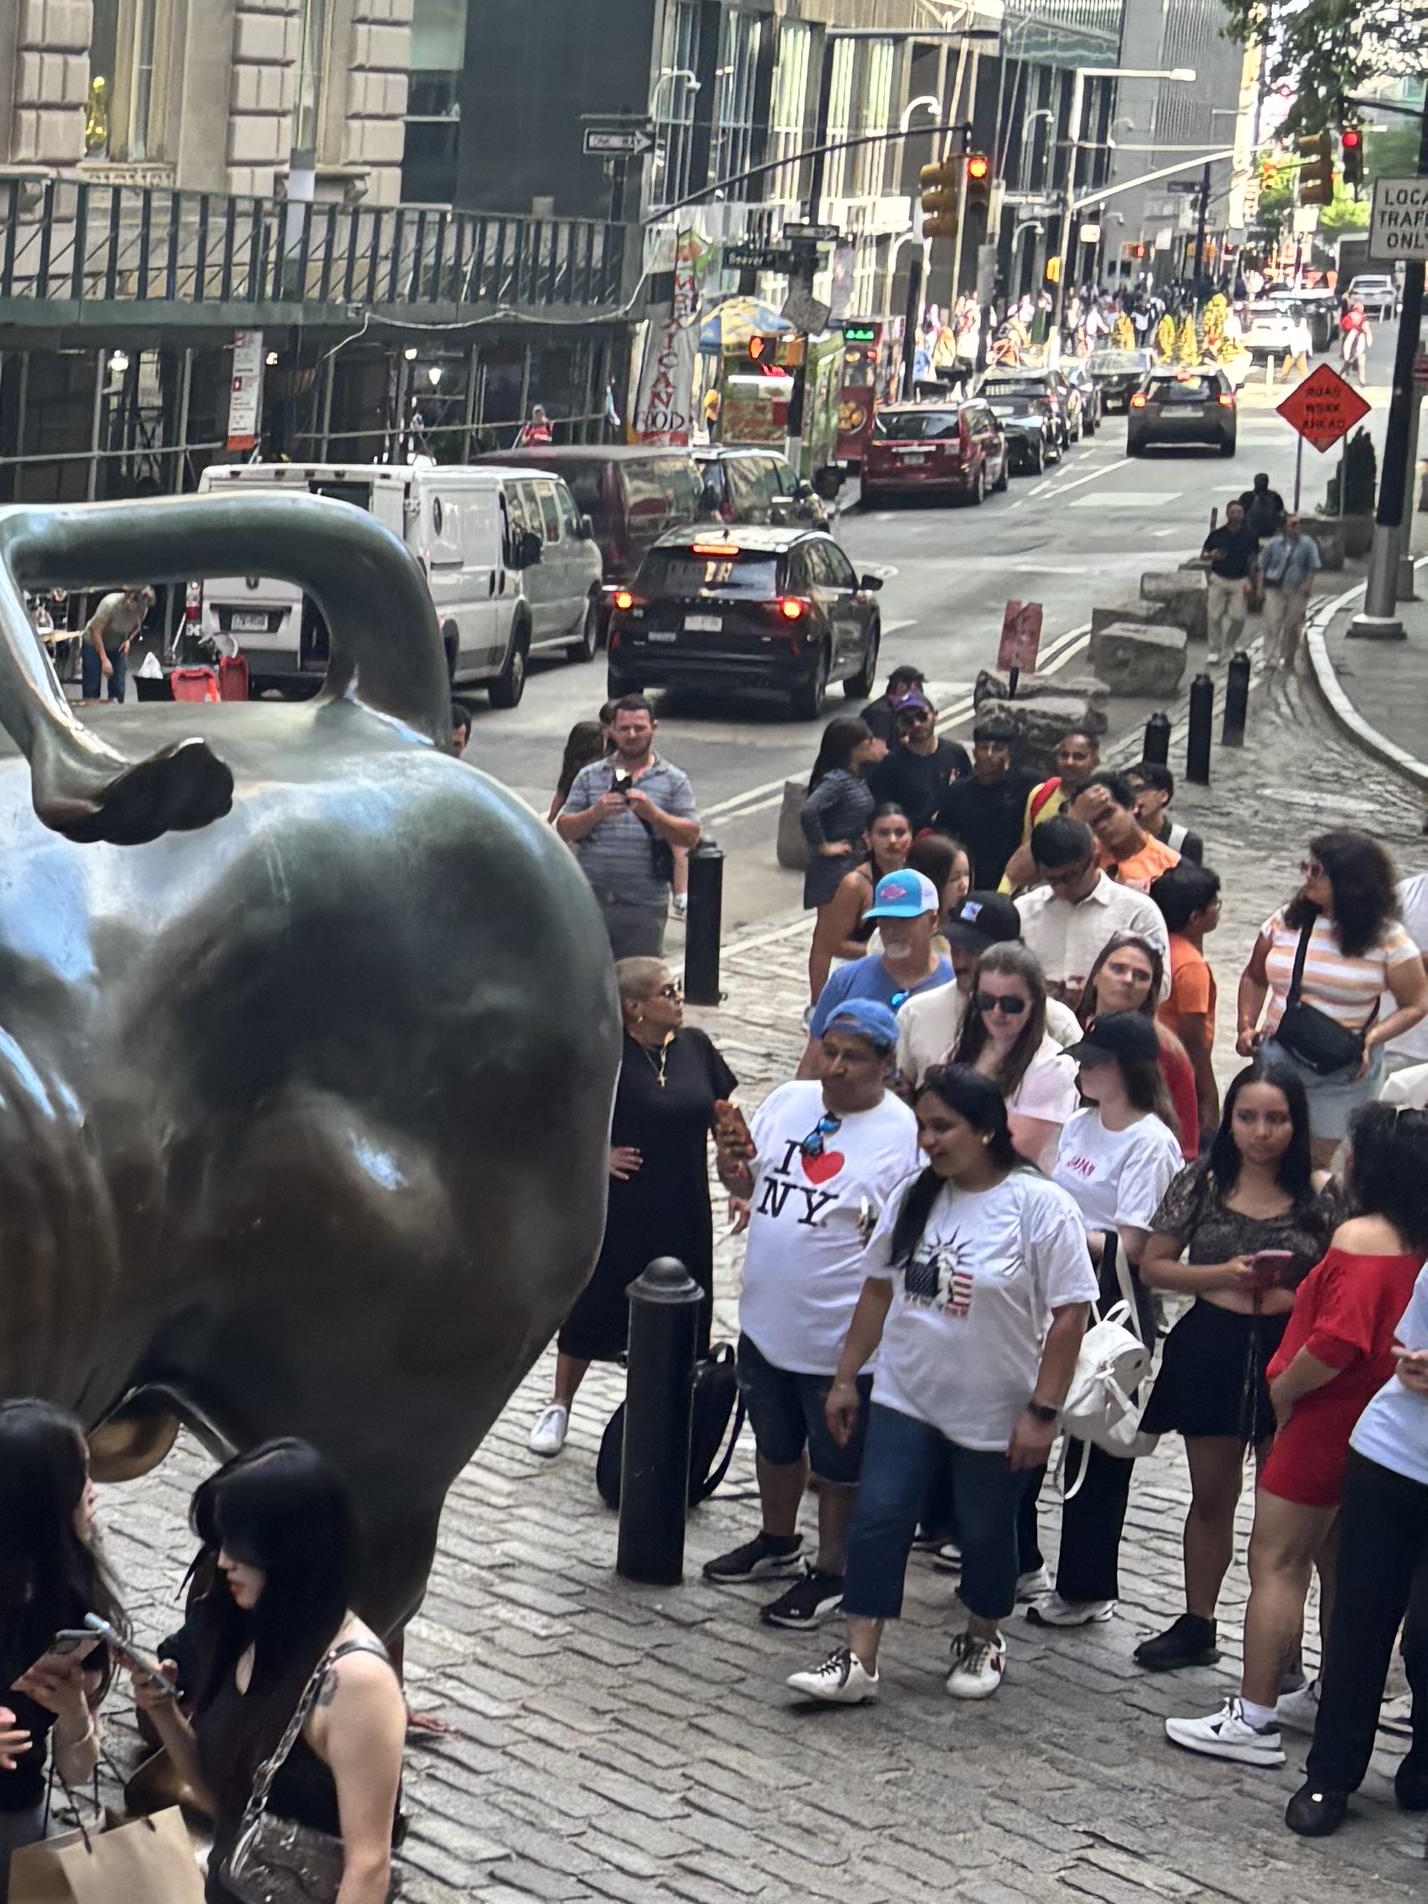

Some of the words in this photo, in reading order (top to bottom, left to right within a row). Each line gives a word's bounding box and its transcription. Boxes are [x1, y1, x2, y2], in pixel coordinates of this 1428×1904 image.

[1379, 210, 1428, 228] TRAF
[729, 252, 764, 265] Beaver
[774, 1139, 800, 1176] I
[756, 1177, 839, 1227] NY
